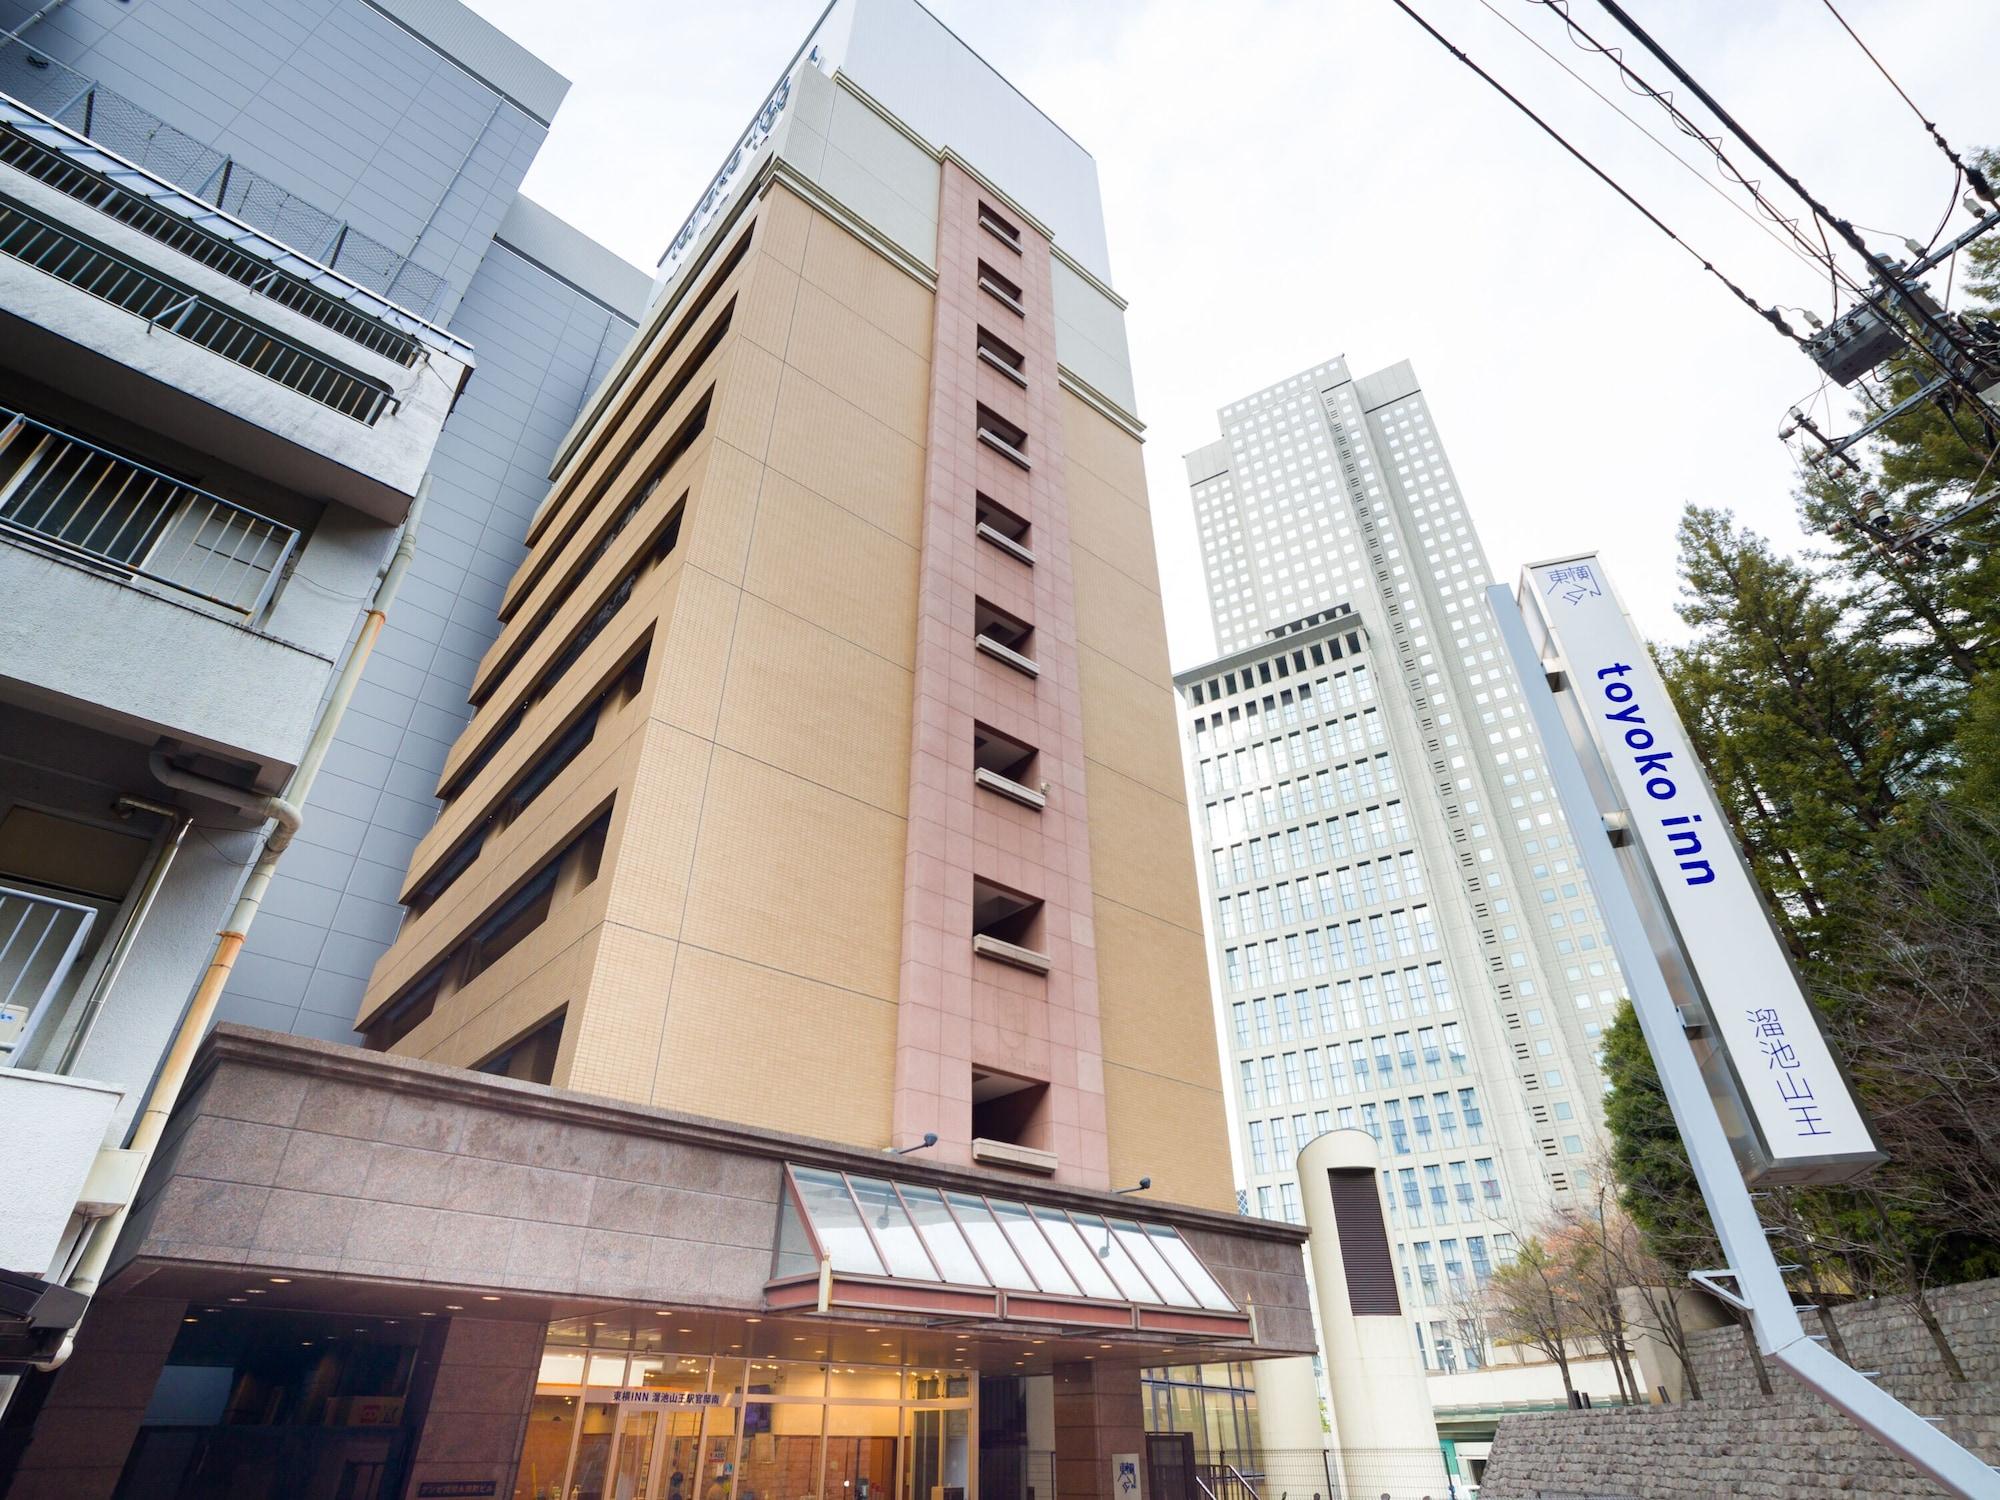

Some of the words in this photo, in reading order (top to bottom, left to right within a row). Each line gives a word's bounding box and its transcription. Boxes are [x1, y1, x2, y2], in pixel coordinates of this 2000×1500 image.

[1597, 663, 1677, 800] toyoko
[1661, 814, 1716, 886] inn
[1746, 1008, 1832, 1136] 溜池山王
[613, 1390, 649, 1402] 東横INN
